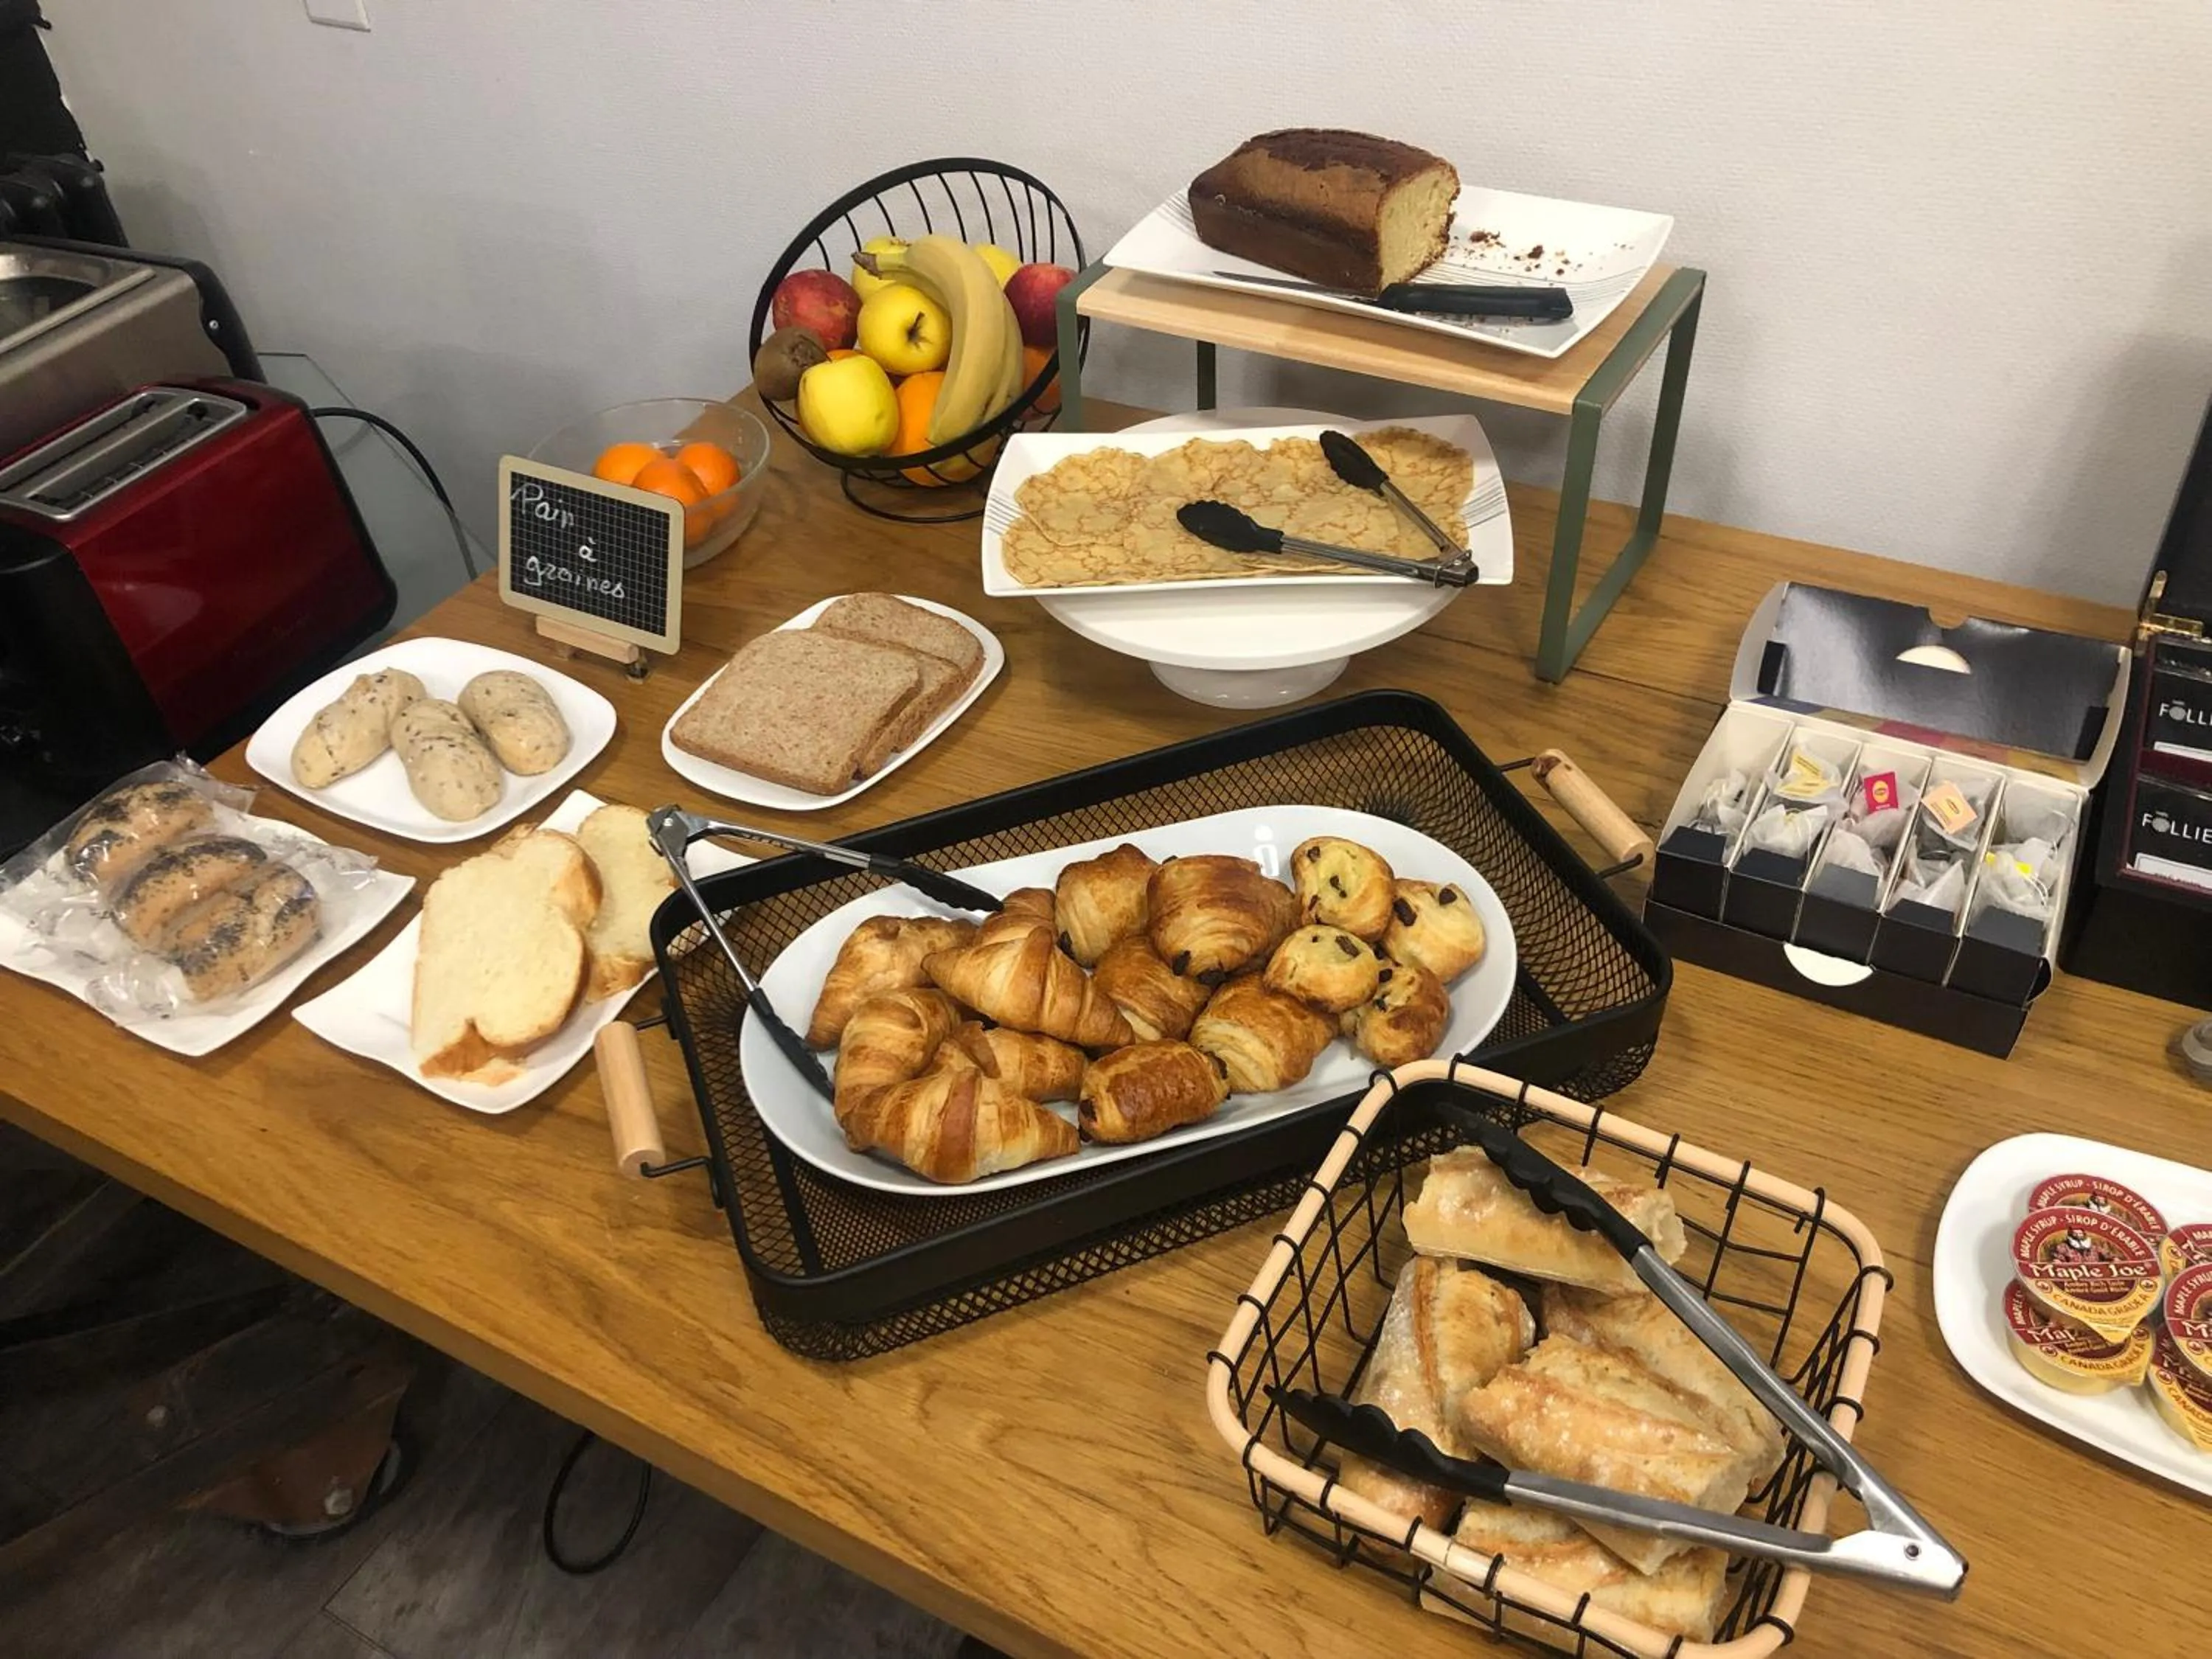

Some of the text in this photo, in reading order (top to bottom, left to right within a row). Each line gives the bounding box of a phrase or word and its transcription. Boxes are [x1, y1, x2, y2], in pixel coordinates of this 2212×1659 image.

[510, 483, 574, 528] Pain
[524, 556, 625, 598] graines
[2054, 1180, 2083, 1192] SYRUP
[2093, 1180, 2124, 1196] SIROP
[2020, 1231, 2035, 1258] MAPLE
[2031, 1216, 2056, 1234] SYRUP
[2065, 1214, 2098, 1226] SIROP
[2029, 1264, 2147, 1281] Maple Joe
[2053, 1294, 2107, 1315] CANADA
[2027, 1328, 2078, 1341] Map
